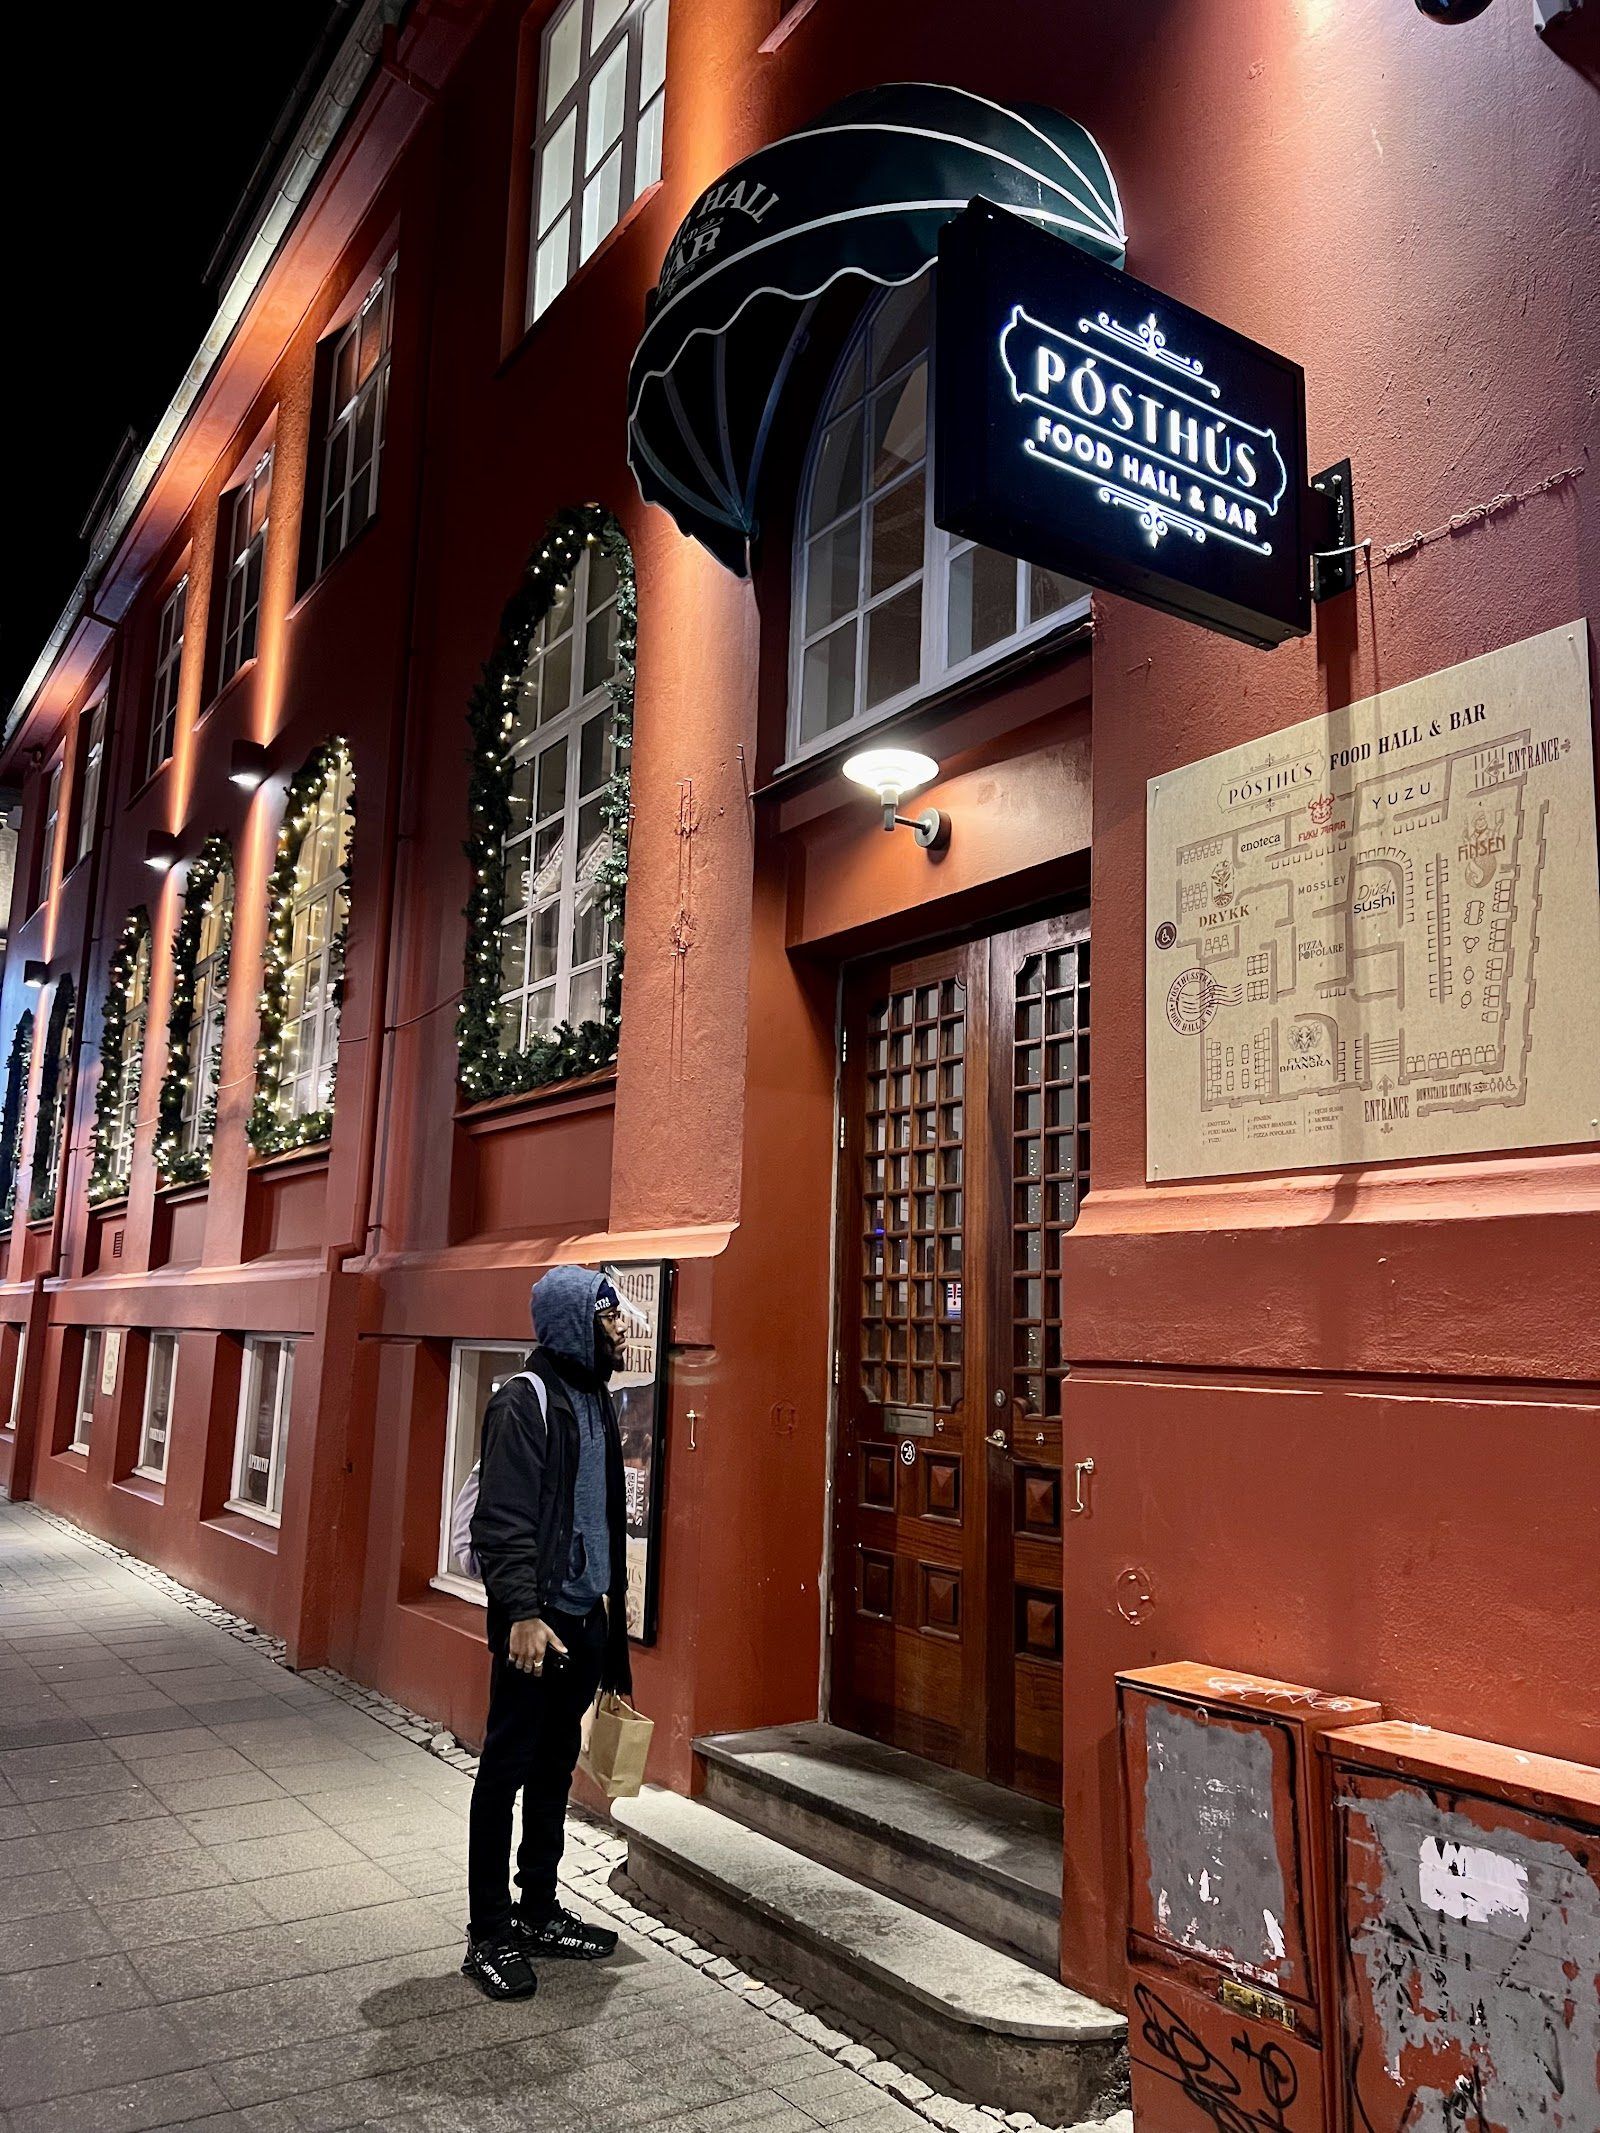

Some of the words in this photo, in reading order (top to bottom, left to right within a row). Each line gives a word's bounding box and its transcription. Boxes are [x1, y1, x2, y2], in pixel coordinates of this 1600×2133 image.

[1036, 346, 1258, 488] PÓSTHÚS
[1038, 416, 1114, 470] FOOD
[1121, 454, 1182, 503] HALL
[1190, 485, 1206, 512] &
[1213, 494, 1259, 535] BAR
[1229, 762, 1312, 805] PÓSTHÚS
[1330, 743, 1371, 771] FOOD
[1378, 725, 1422, 755] HALL
[1429, 719, 1441, 737] &
[1450, 703, 1487, 731] BAR
[1508, 737, 1560, 775] ENTRANCE
[1372, 782, 1431, 810] YUZU
[1240, 834, 1281, 853] enoteca
[1298, 875, 1346, 895] MOSSLEY
[1353, 891, 1395, 914] sushi
[1199, 905, 1250, 928] DRYKK
[1299, 940, 1323, 953] PIZZA
[1299, 943, 1345, 961] POPOLARE
[1280, 1059, 1331, 1072] BHANGRA
[1288, 1053, 1323, 1064] FUNKY
[1365, 1096, 1409, 1122] ENTRANCE
[624, 1309, 653, 1339] ALL
[558, 1937, 582, 1948] JUST
